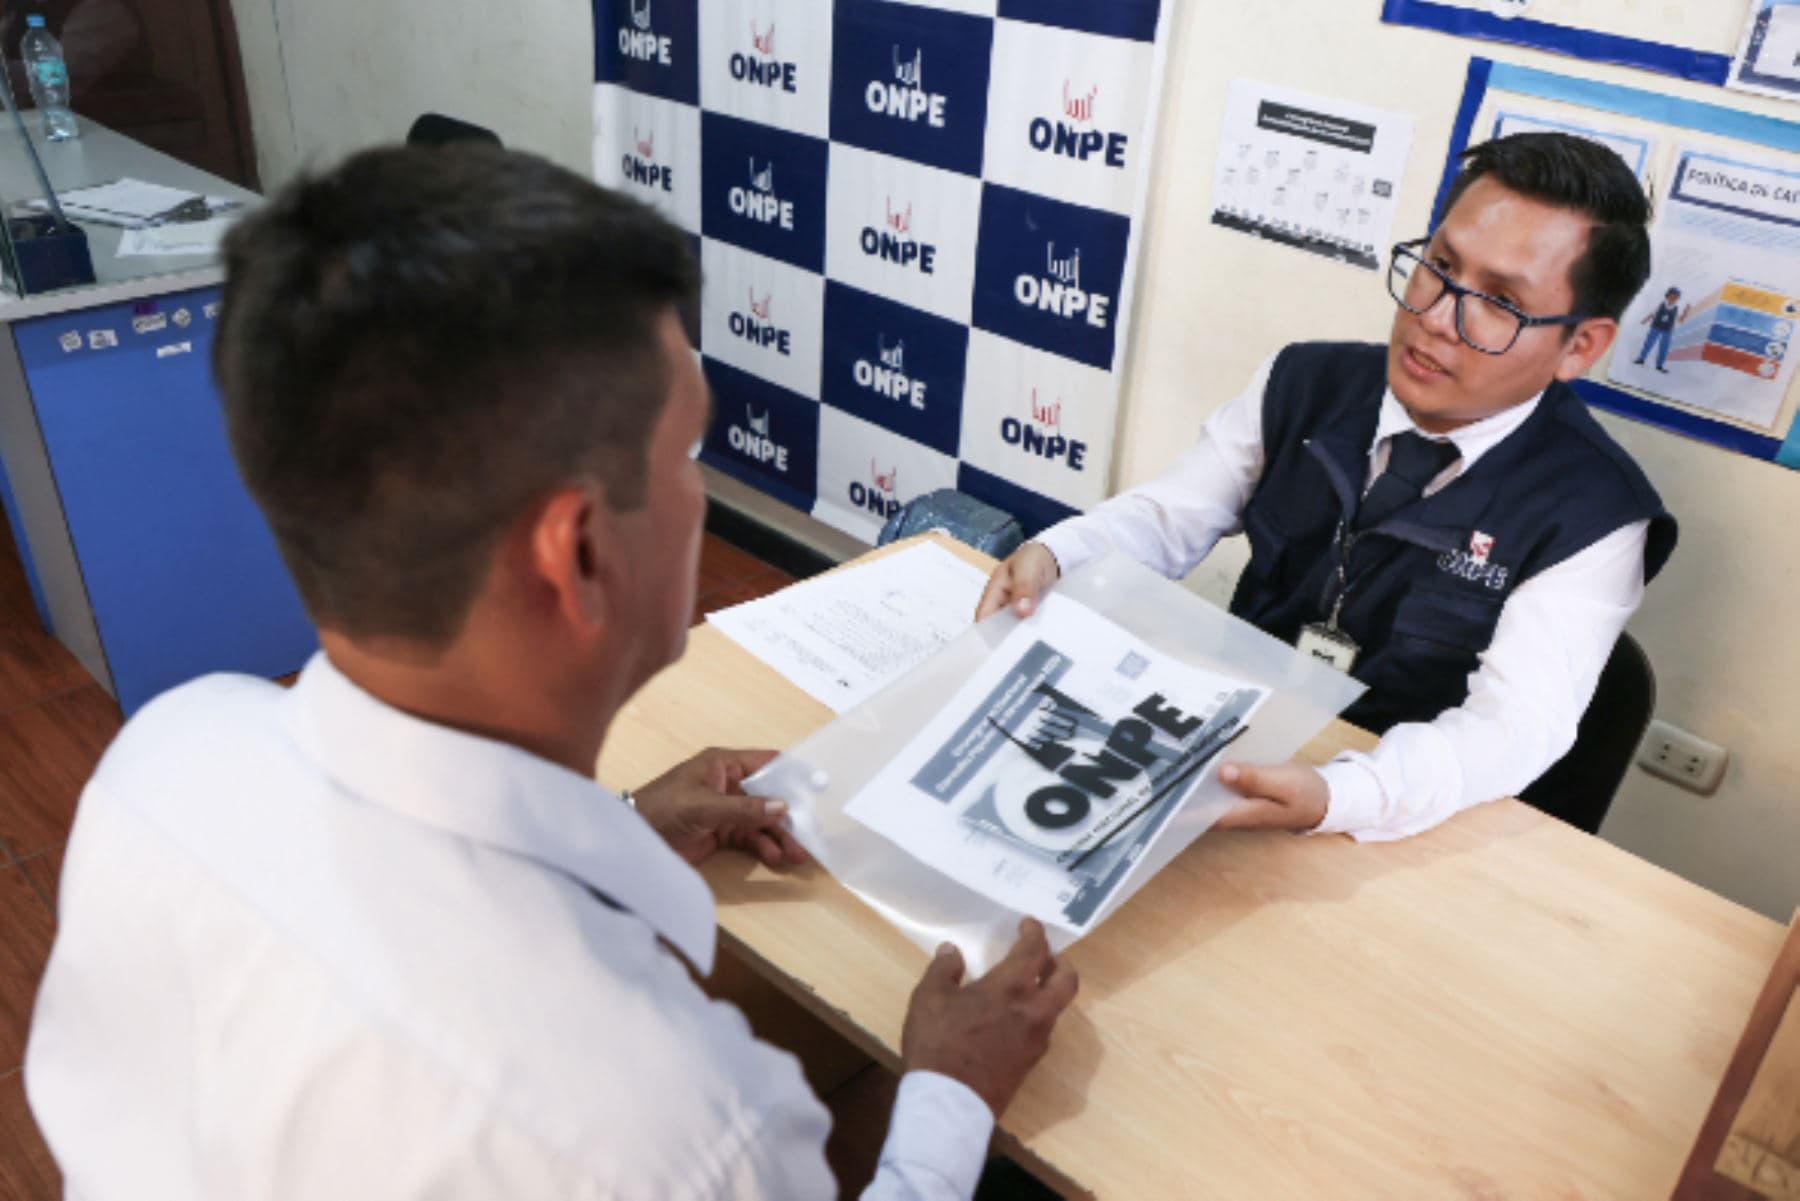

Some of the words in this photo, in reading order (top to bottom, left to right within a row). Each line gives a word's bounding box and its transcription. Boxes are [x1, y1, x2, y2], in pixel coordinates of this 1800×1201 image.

[618, 28, 672, 66] ONPE
[730, 53, 796, 93] ONPE
[865, 82, 946, 127] ONPE
[1029, 118, 1128, 167] ONPE
[621, 154, 672, 192] ONPE
[728, 187, 794, 230] ONPE
[860, 227, 935, 275] ONPE
[1014, 275, 1109, 328] ONPE
[728, 313, 791, 355] ONPE
[853, 360, 927, 410] ONPE
[728, 427, 788, 472] ONPE
[1000, 418, 1088, 470] ONPE
[849, 481, 901, 520] ONP
[1024, 692, 1204, 830] ONPE
